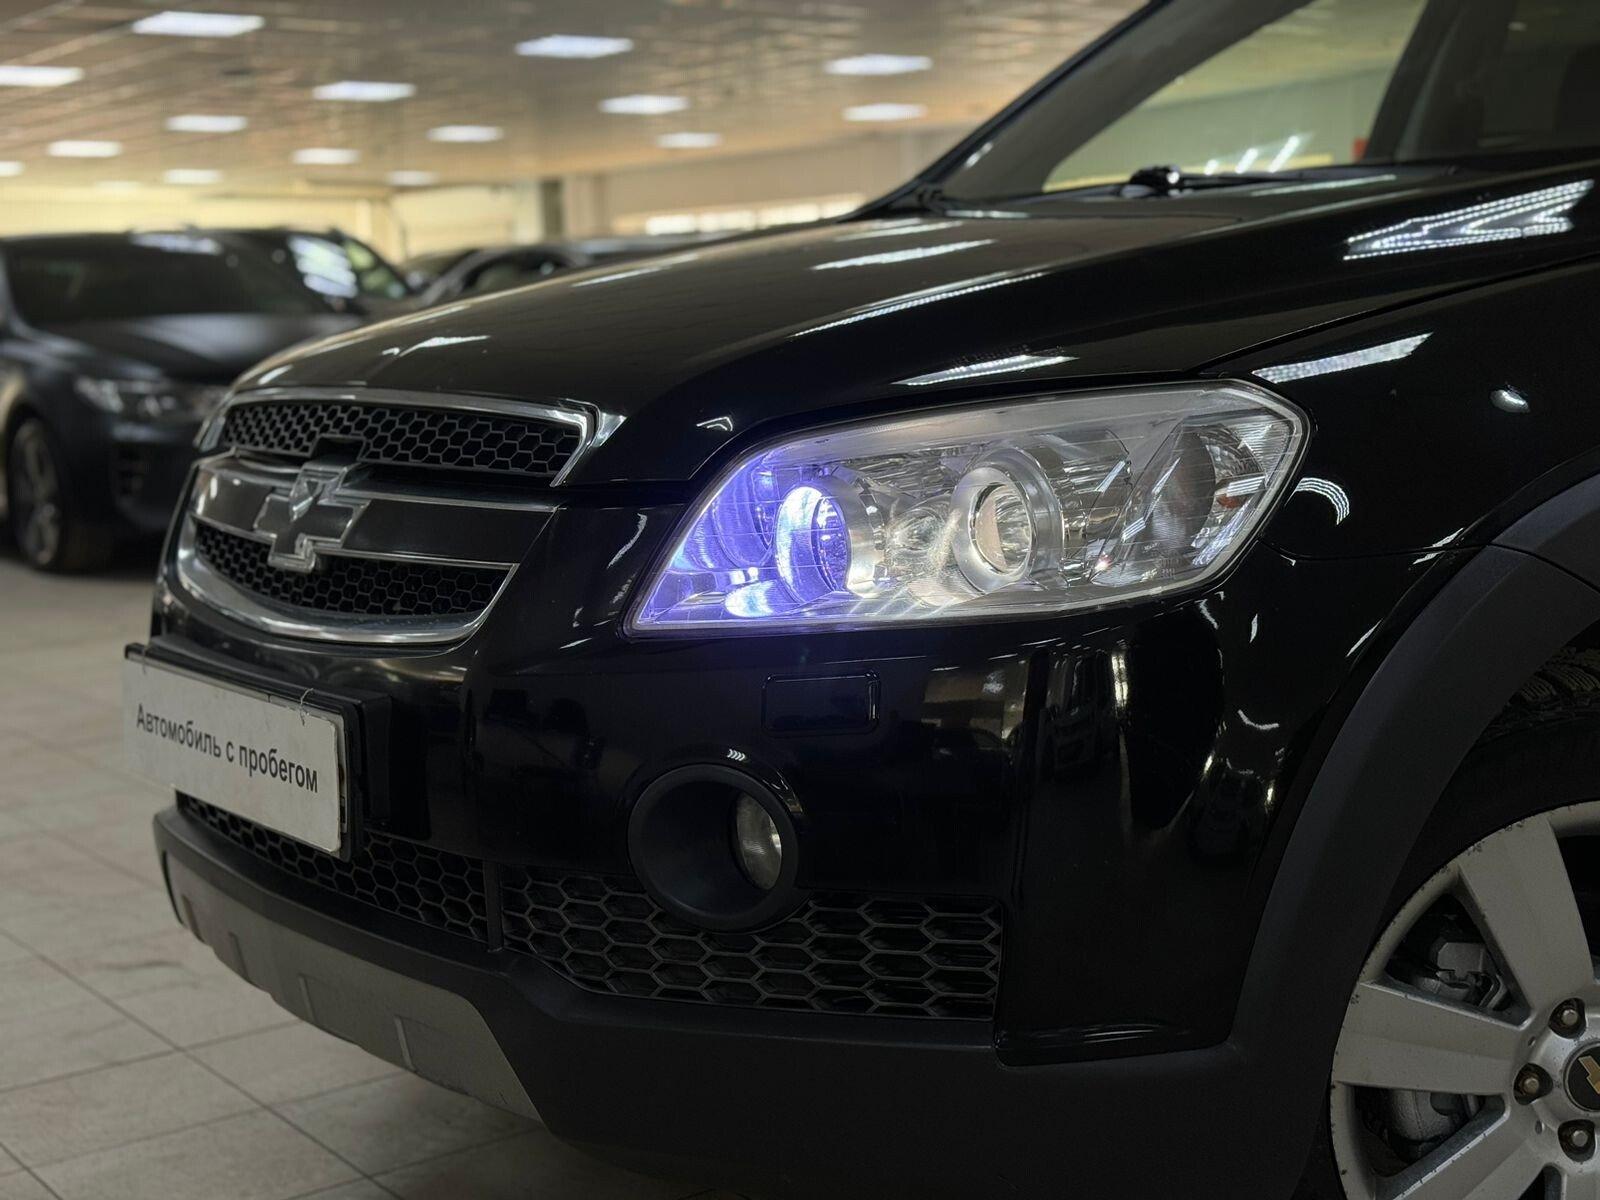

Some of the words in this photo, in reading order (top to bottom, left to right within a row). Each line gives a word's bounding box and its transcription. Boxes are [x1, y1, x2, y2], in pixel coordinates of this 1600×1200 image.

[136, 703, 221, 757] Автомобиль
[226, 741, 234, 762] с
[239, 745, 318, 793] пробегом
